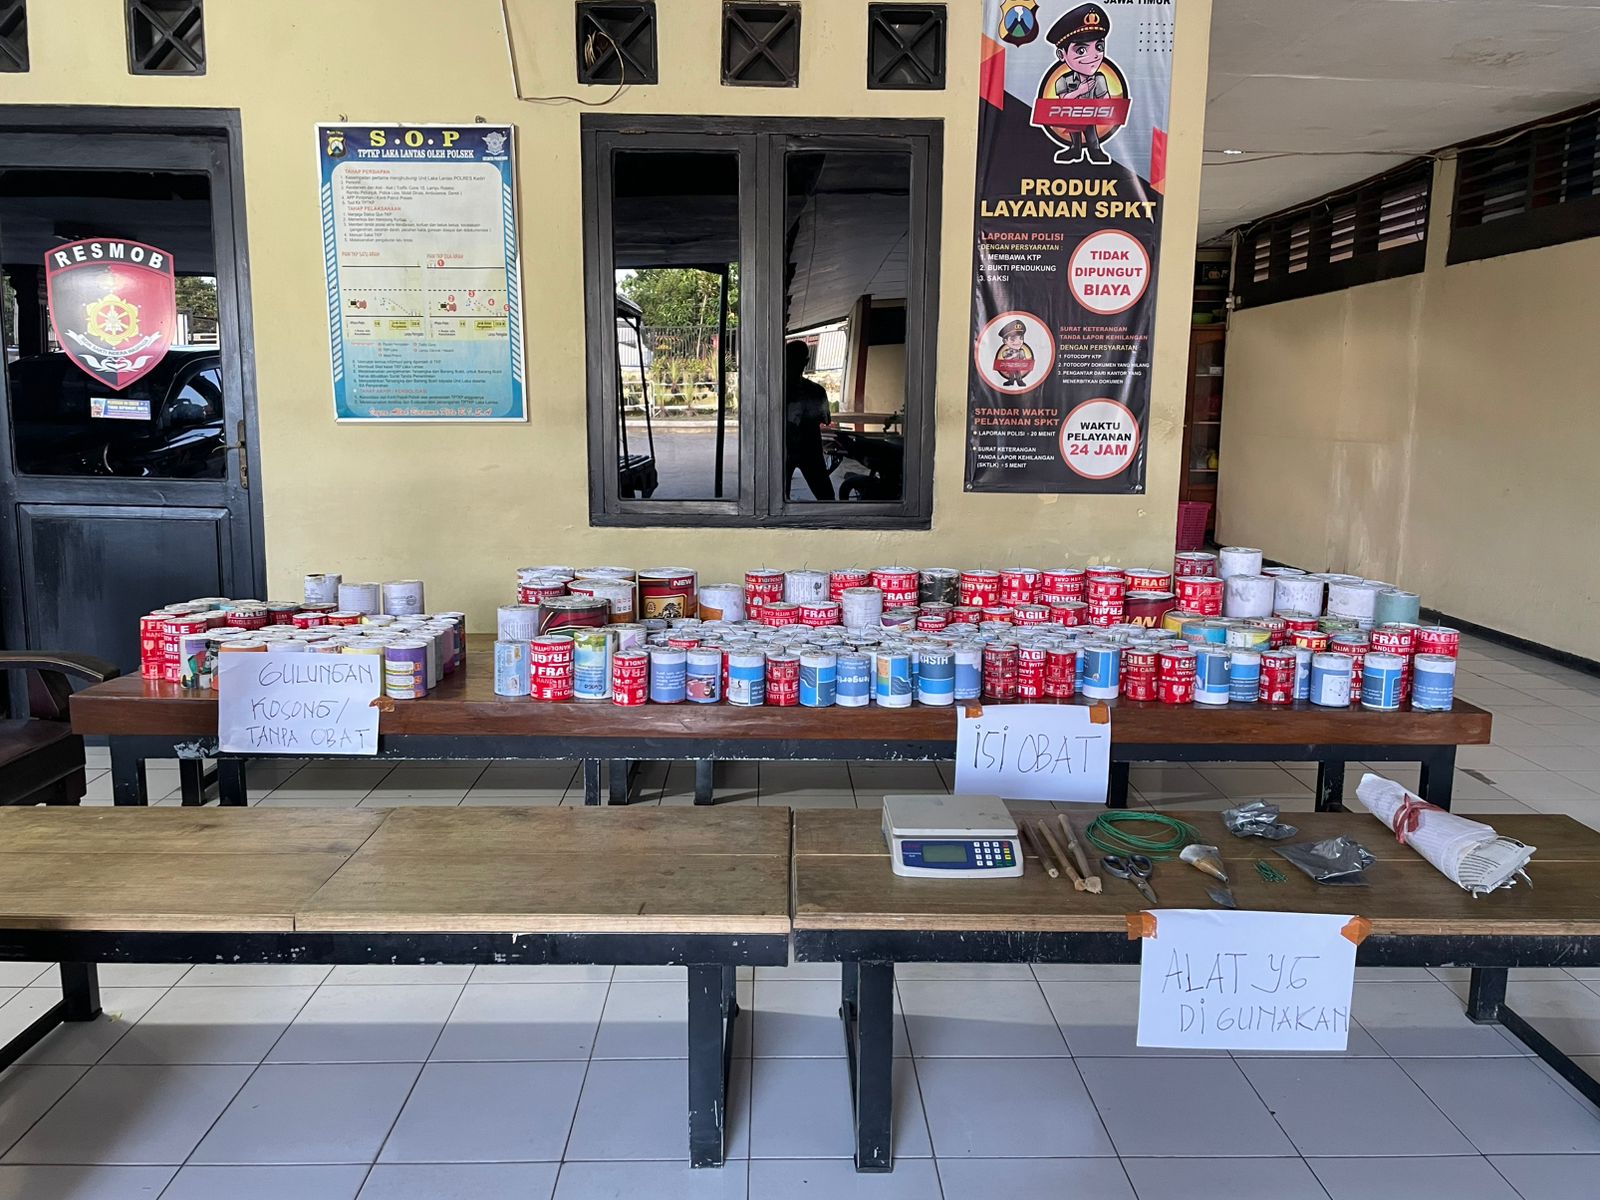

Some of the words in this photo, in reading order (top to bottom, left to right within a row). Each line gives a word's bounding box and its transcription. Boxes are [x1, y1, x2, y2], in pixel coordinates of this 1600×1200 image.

[1049, 106, 1115, 118] PRESISI
[358, 149, 380, 158] TPTKP
[382, 149, 400, 158] LAKA
[400, 149, 426, 158] LANTAS
[426, 149, 446, 158] OLEH
[446, 149, 474, 158] POLSEK
[1020, 178, 1118, 196] PRODUK
[980, 201, 1087, 218] LAYANAN
[1095, 202, 1156, 218] SPKT
[982, 232, 1028, 240] LAPORAN
[54, 242, 164, 268] RESMOB
[1090, 251, 1129, 260] TIDAK
[1075, 267, 1143, 277] DIPUNGUT
[1084, 284, 1131, 296] BIAYA
[975, 408, 1019, 416] STANDAR
[974, 418, 1031, 426] PELAYANAN
[1067, 433, 1131, 441] PELAYANAN
[1070, 444, 1088, 456] 24
[1094, 444, 1128, 456] JAM
[673, 578, 693, 586] NEW
[258, 662, 374, 686] GULUNGAN
[246, 726, 299, 747] TANPA
[311, 728, 370, 748] OBAT
[1017, 734, 1102, 774] OBAT
[1162, 948, 1248, 994] ALAT
[1216, 1005, 1348, 1033] GUNAKAN
